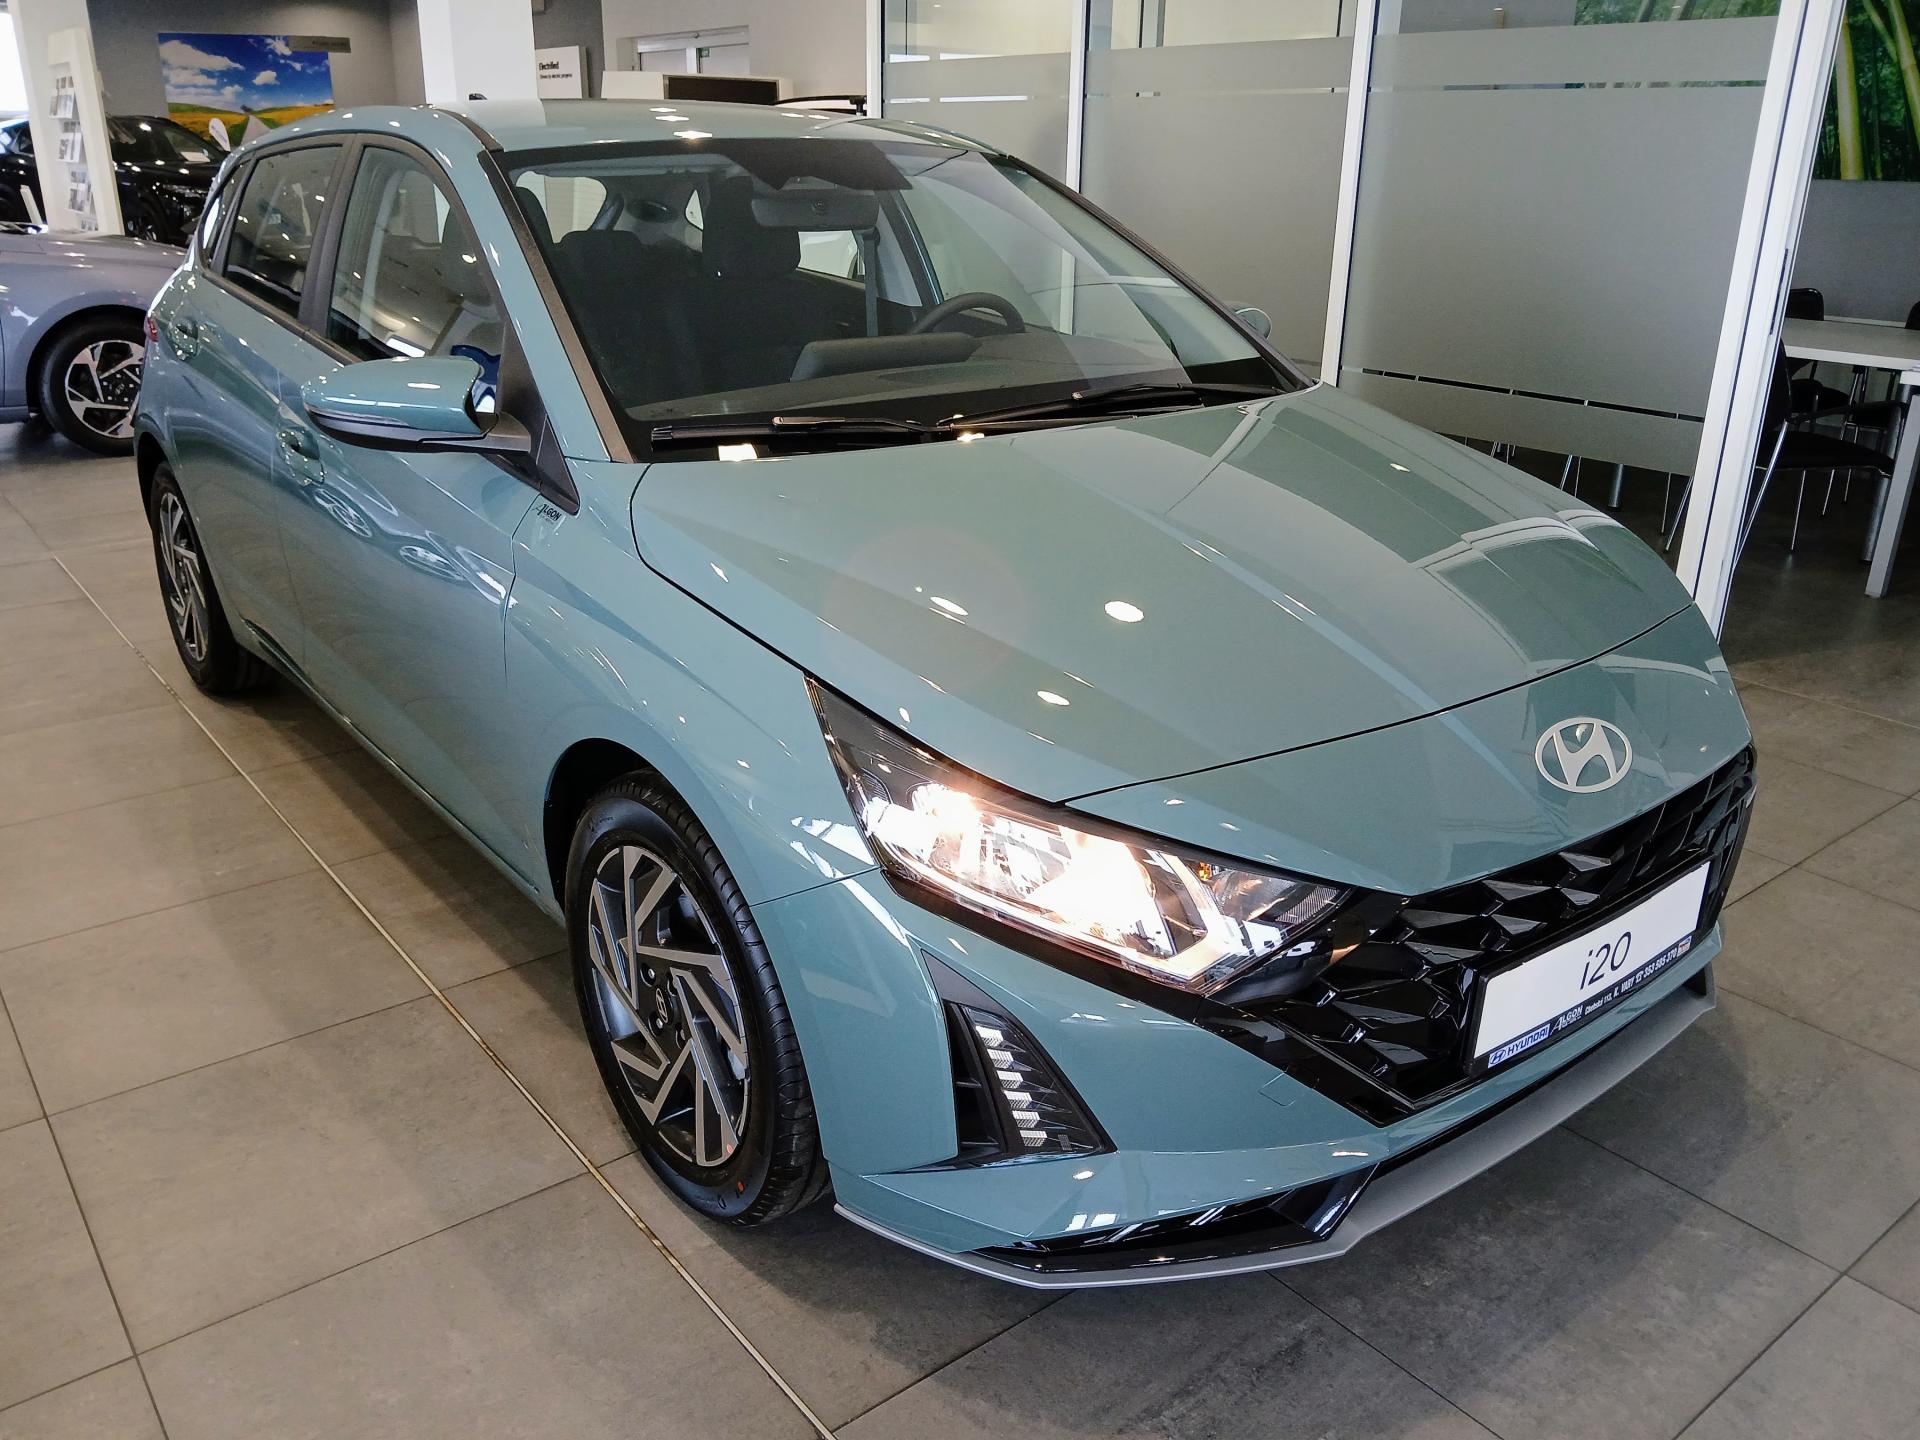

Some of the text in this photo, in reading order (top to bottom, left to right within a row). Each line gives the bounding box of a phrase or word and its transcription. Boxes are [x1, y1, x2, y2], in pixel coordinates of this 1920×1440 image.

[1580, 931, 1632, 990] i20
[1507, 1026, 1549, 1056] HYUNDAI
[1550, 1005, 1583, 1035] ALGON
